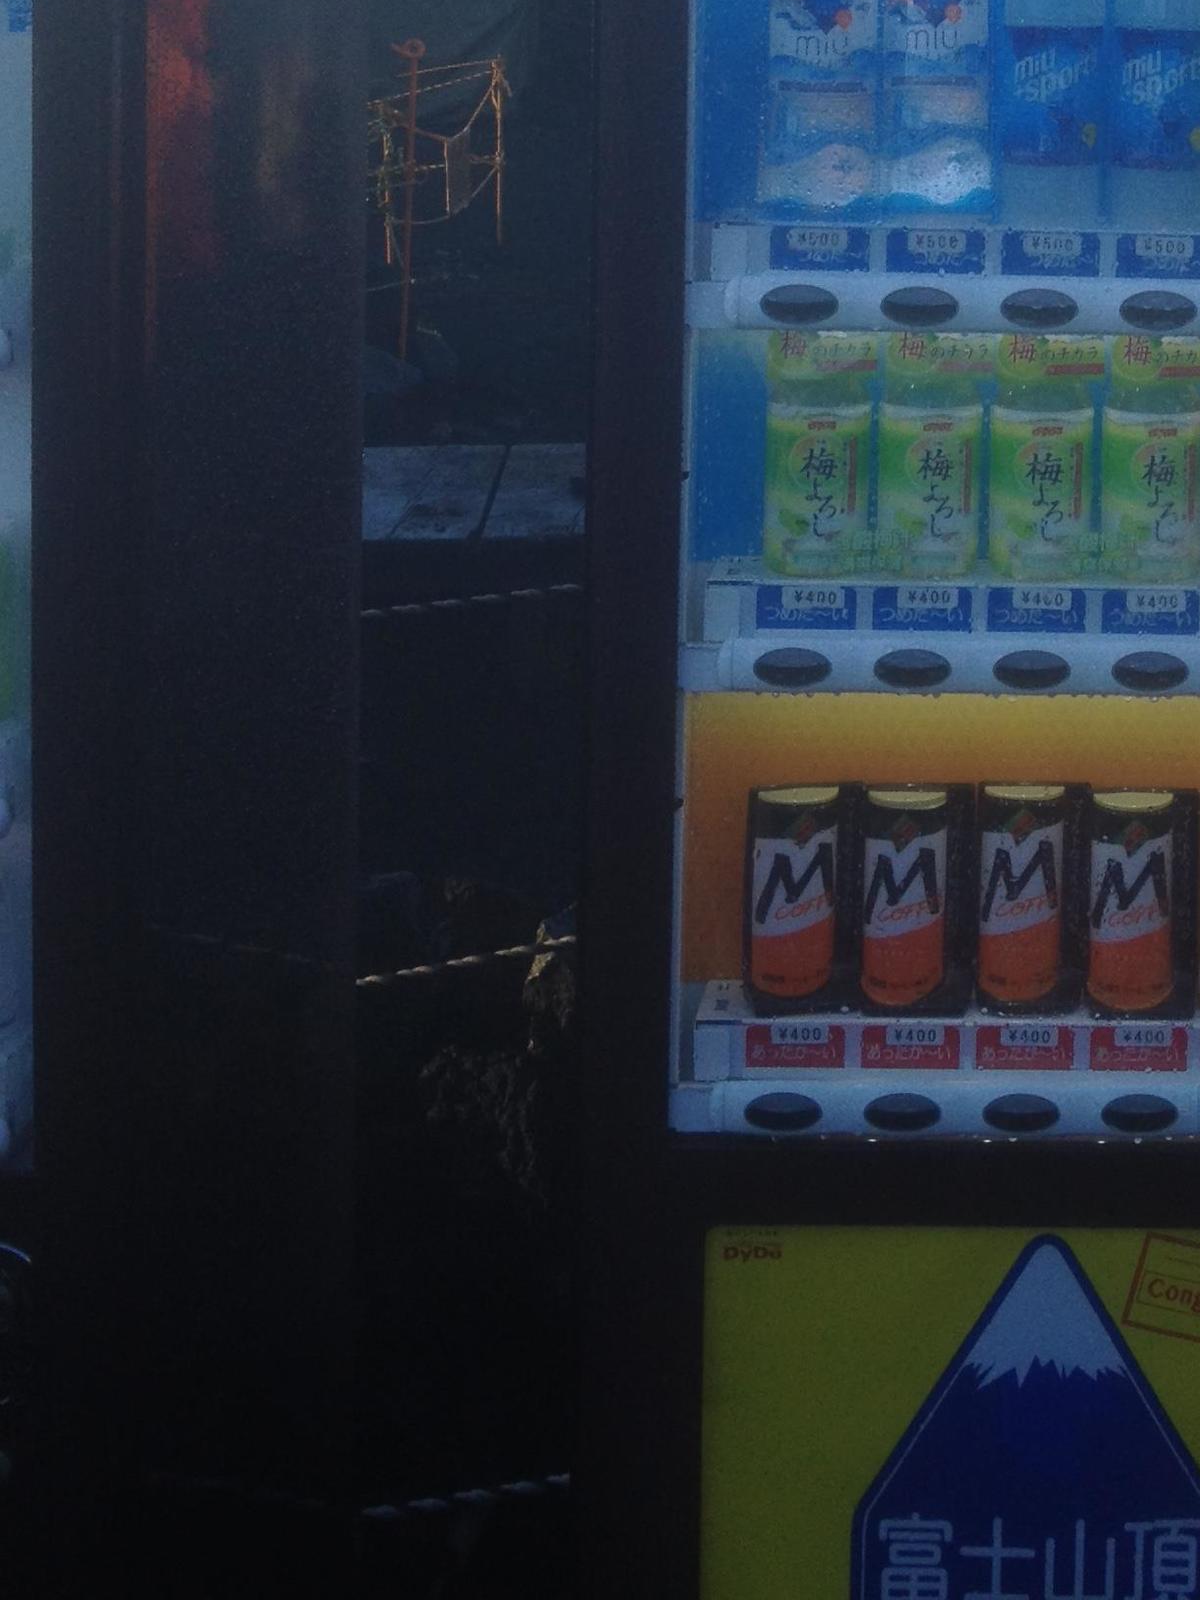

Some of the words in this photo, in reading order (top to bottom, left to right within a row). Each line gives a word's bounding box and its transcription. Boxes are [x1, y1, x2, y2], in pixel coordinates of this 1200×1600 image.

[800, 446, 839, 538] 梅よろし
[917, 447, 956, 539] 梅よろし
[1025, 451, 1066, 543] 梅よろし
[1141, 454, 1179, 545] 梅よろし
[794, 590, 837, 606] ¥400
[907, 590, 951, 605] ¥400
[1020, 591, 1064, 607] ¥400
[1136, 592, 1179, 608] ¥400
[755, 842, 836, 925] M
[866, 846, 941, 926] M
[981, 839, 1058, 924] M
[1091, 848, 1170, 930] M
[778, 1027, 822, 1042] ¥400
[896, 1028, 937, 1043] ¥400
[1009, 1028, 1051, 1044] ¥400
[1123, 1029, 1165, 1044] ¥400
